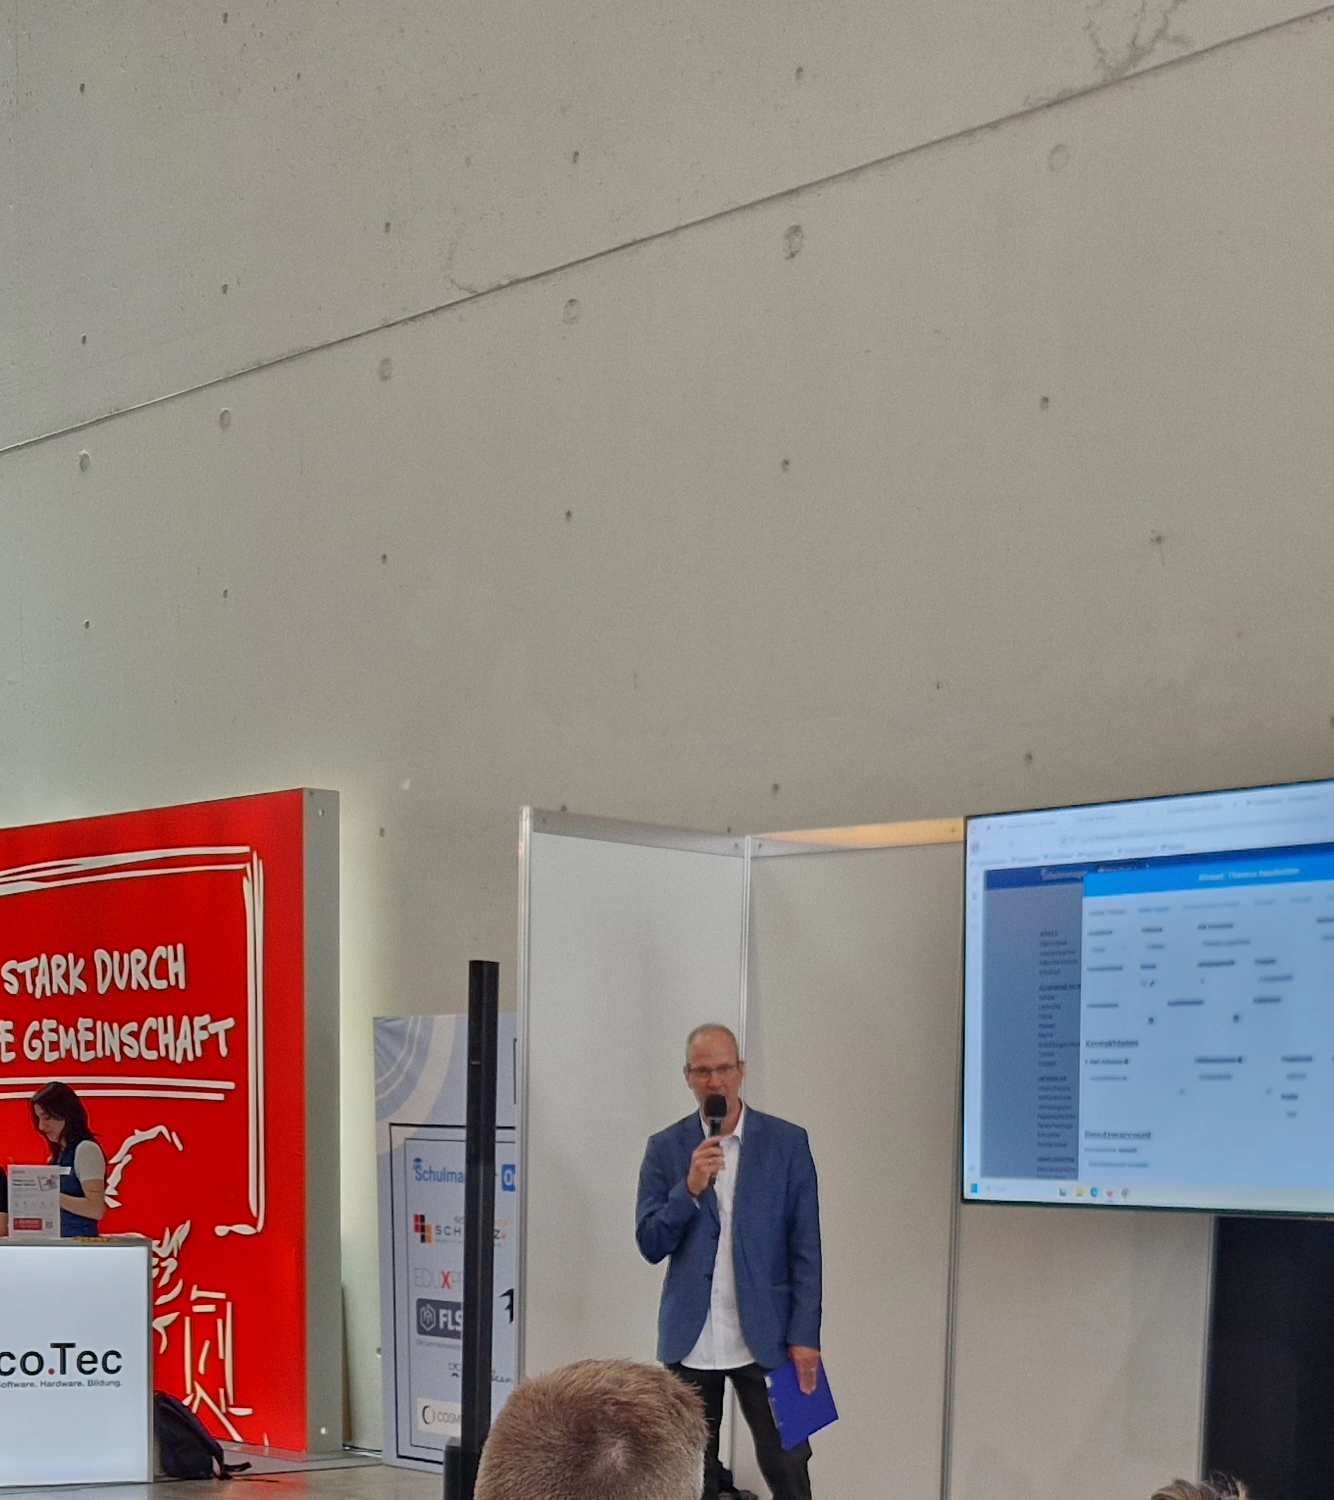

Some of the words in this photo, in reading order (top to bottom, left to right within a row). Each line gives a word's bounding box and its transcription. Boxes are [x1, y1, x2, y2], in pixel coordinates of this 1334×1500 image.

[0, 953, 87, 999] STARK
[94, 943, 186, 994] DURCH
[23, 1013, 236, 1064] GEMEINSCHAFT
[415, 1165, 466, 1184] Schulma
[40, 1379, 85, 1388] Hardware.
[87, 1379, 123, 1388] Bildung.
